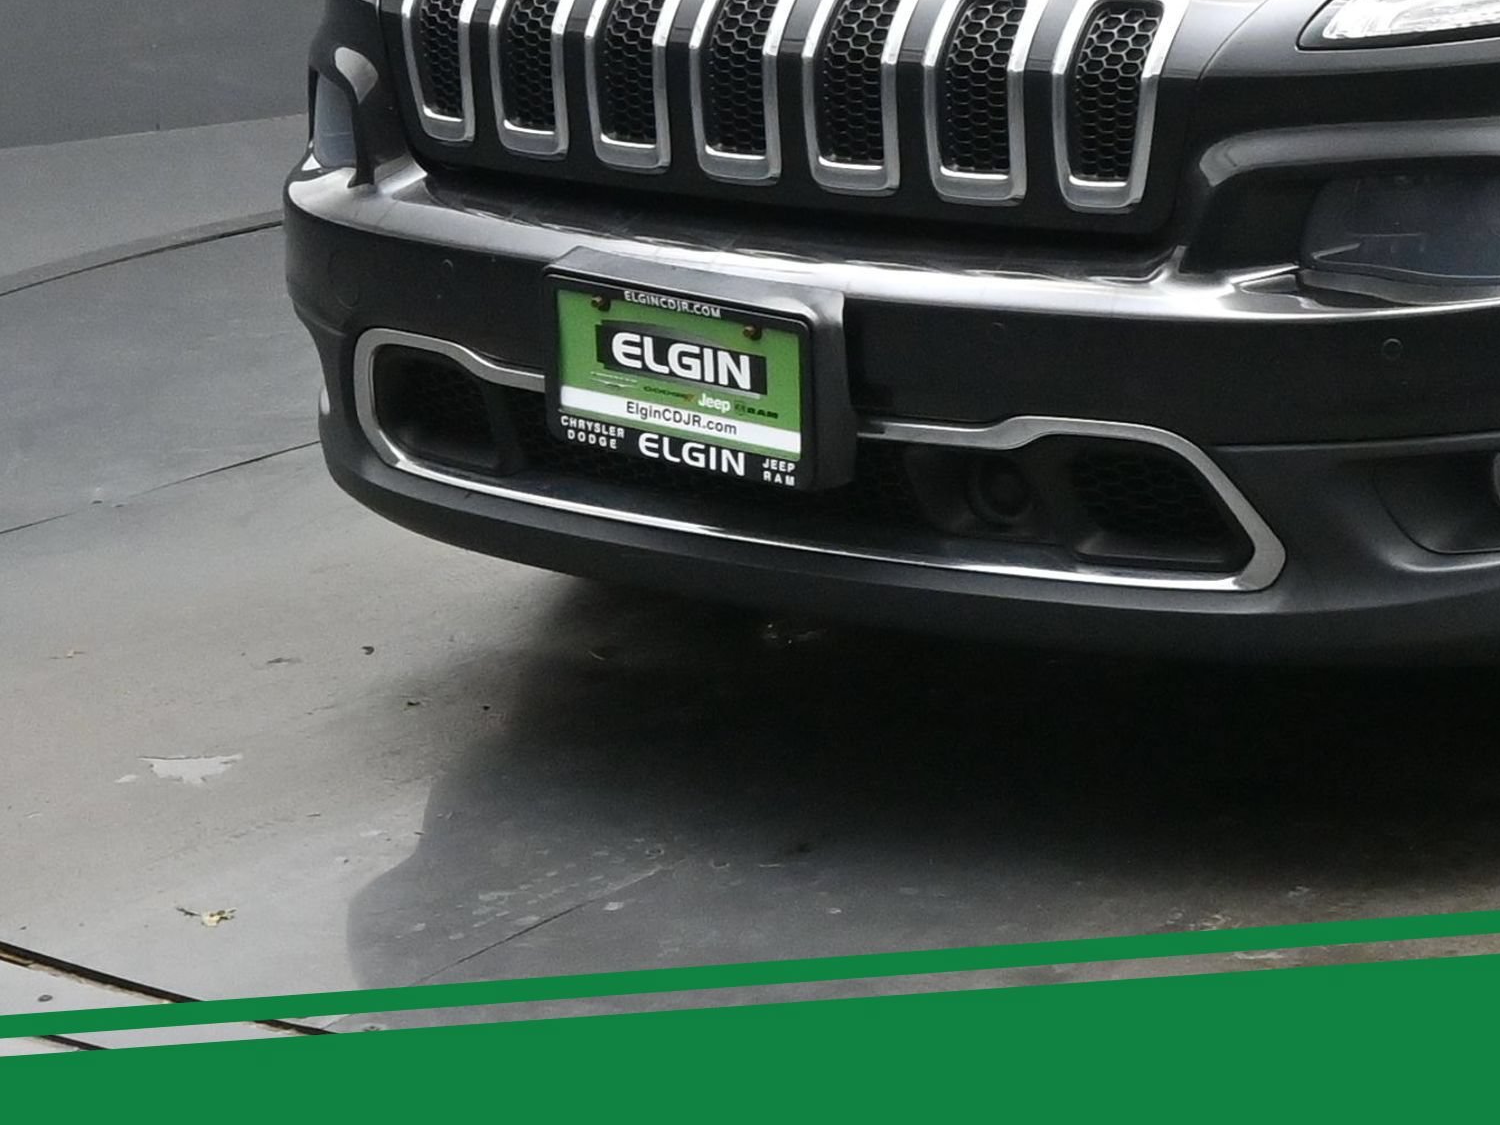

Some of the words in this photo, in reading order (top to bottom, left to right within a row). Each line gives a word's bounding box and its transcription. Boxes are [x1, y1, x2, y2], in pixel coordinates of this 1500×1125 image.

[623, 291, 722, 319] ELGINCDJR.COM
[611, 331, 751, 391] ELGIN
[698, 393, 731, 414] Jeep
[560, 415, 625, 439] CHRYSLER
[626, 401, 738, 435] ElginCDJR.com
[567, 429, 618, 450] DODGE
[637, 432, 745, 477] ELGIN
[762, 457, 796, 474] JEEP
[762, 470, 796, 487] RAM
